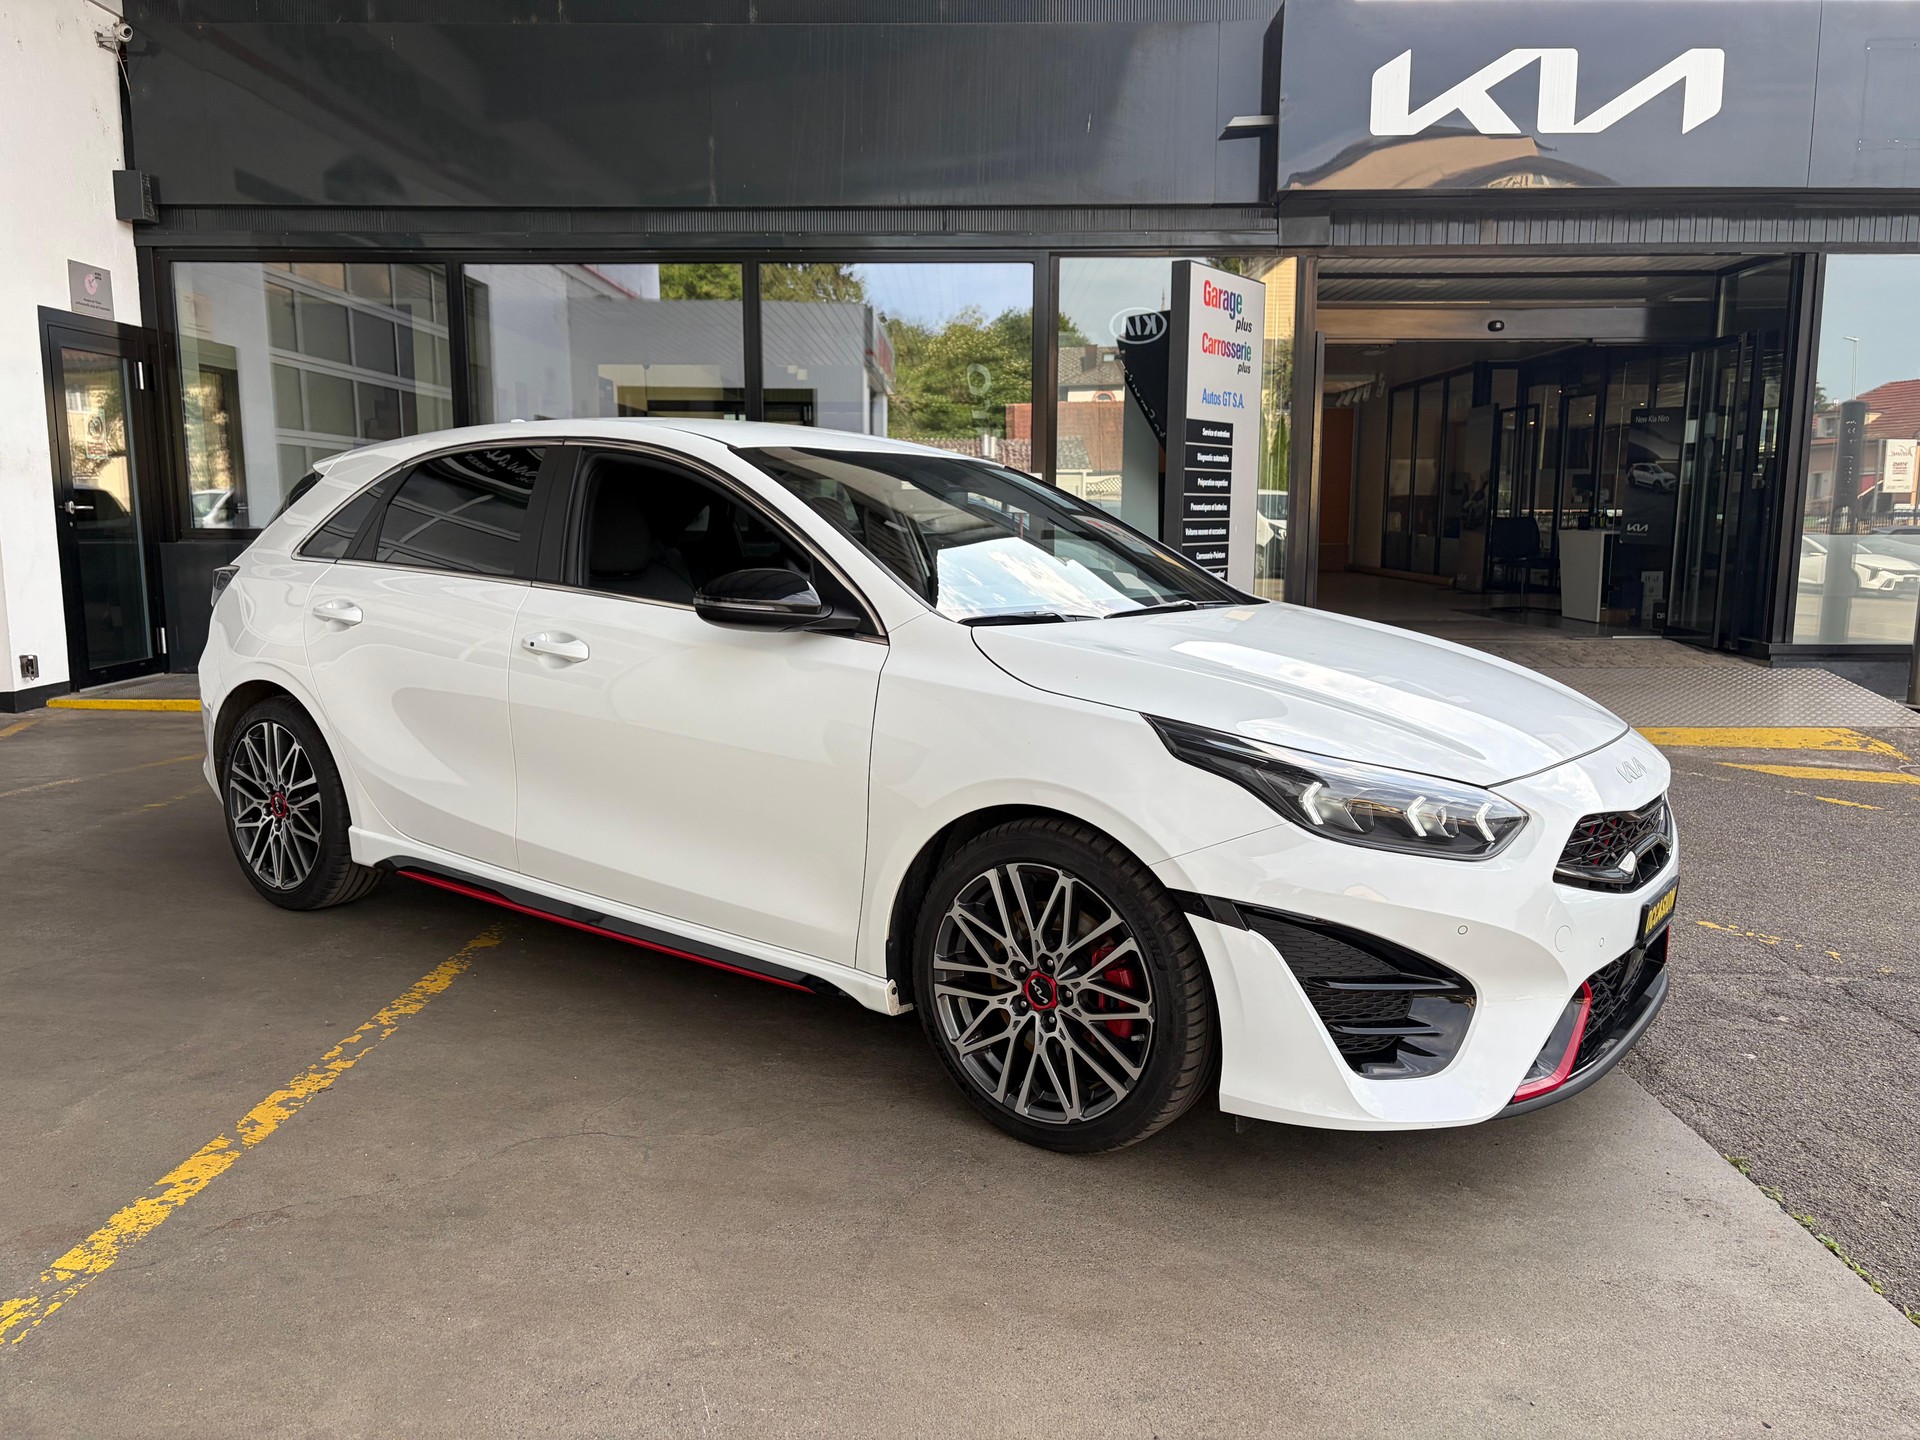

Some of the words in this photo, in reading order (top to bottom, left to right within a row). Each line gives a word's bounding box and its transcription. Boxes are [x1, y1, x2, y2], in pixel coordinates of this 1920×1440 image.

[1369, 47, 1725, 135] KIA
[1203, 279, 1243, 320] Garage
[1235, 317, 1252, 333] plus
[1202, 332, 1252, 362] Carrosserie
[1237, 362, 1251, 374] plus
[1201, 388, 1222, 406] Autos
[1222, 391, 1232, 408] GT
[1635, 415, 1648, 424] New
[1648, 414, 1658, 423] Kia
[1658, 414, 1670, 423] Niro
[1645, 884, 1678, 935] OCCASION
